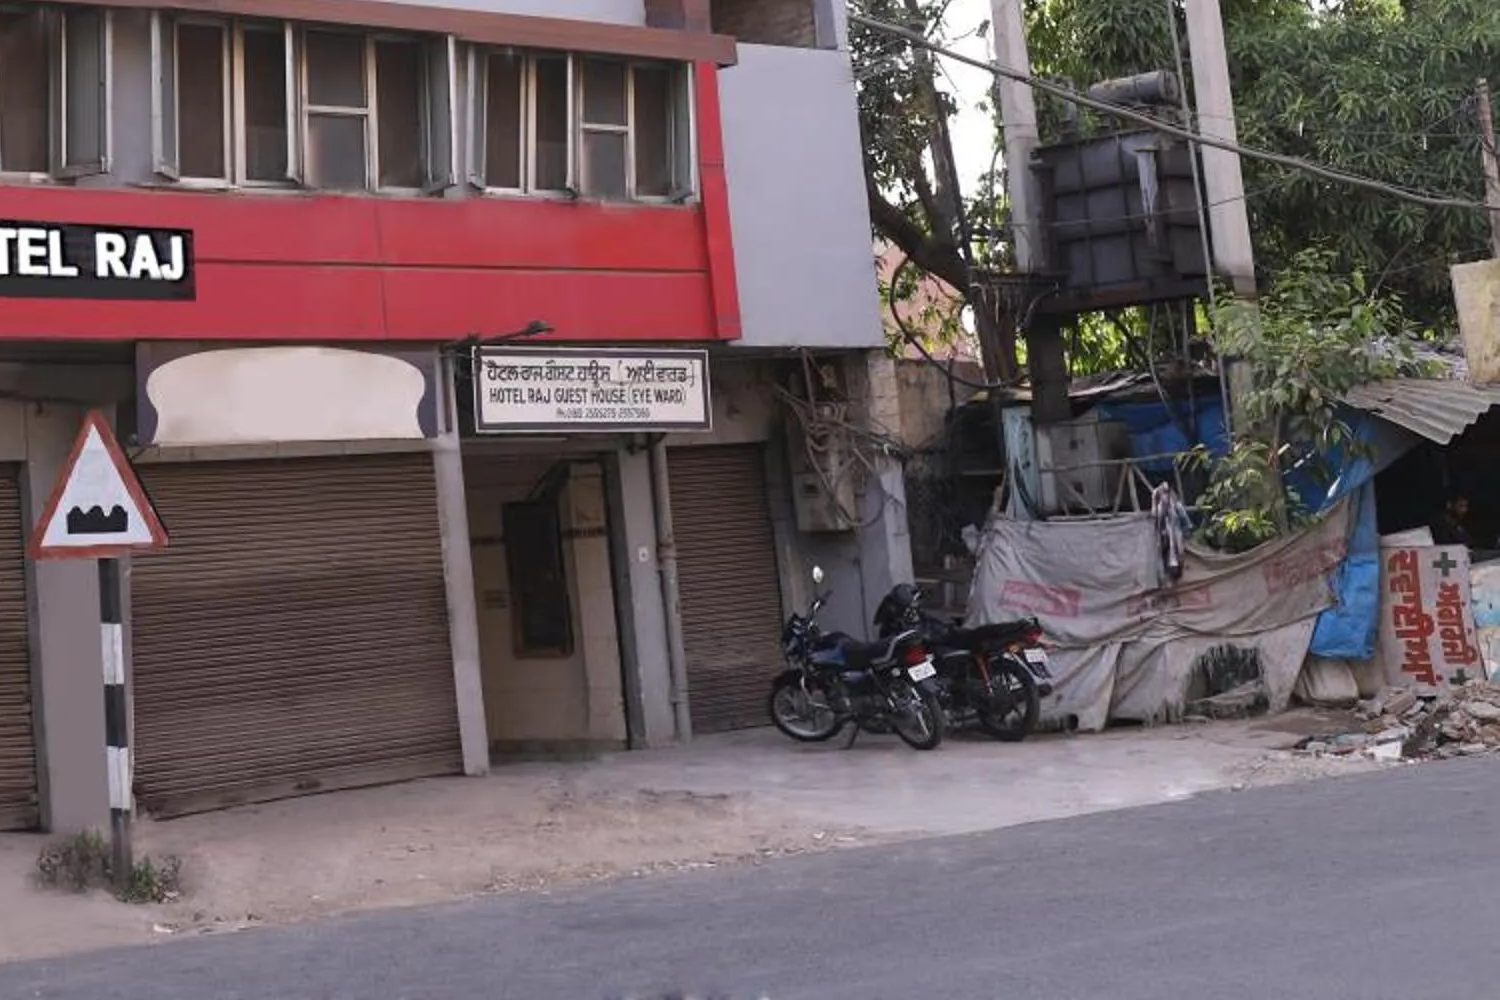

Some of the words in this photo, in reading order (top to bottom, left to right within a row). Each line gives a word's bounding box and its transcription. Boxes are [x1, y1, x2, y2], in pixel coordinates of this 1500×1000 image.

[95, 232, 186, 281] RAJ
[489, 387, 526, 404] HOTEL
[528, 388, 551, 404] RAJ
[554, 388, 588, 404] GUEST
[591, 388, 626, 404] HOUSE
